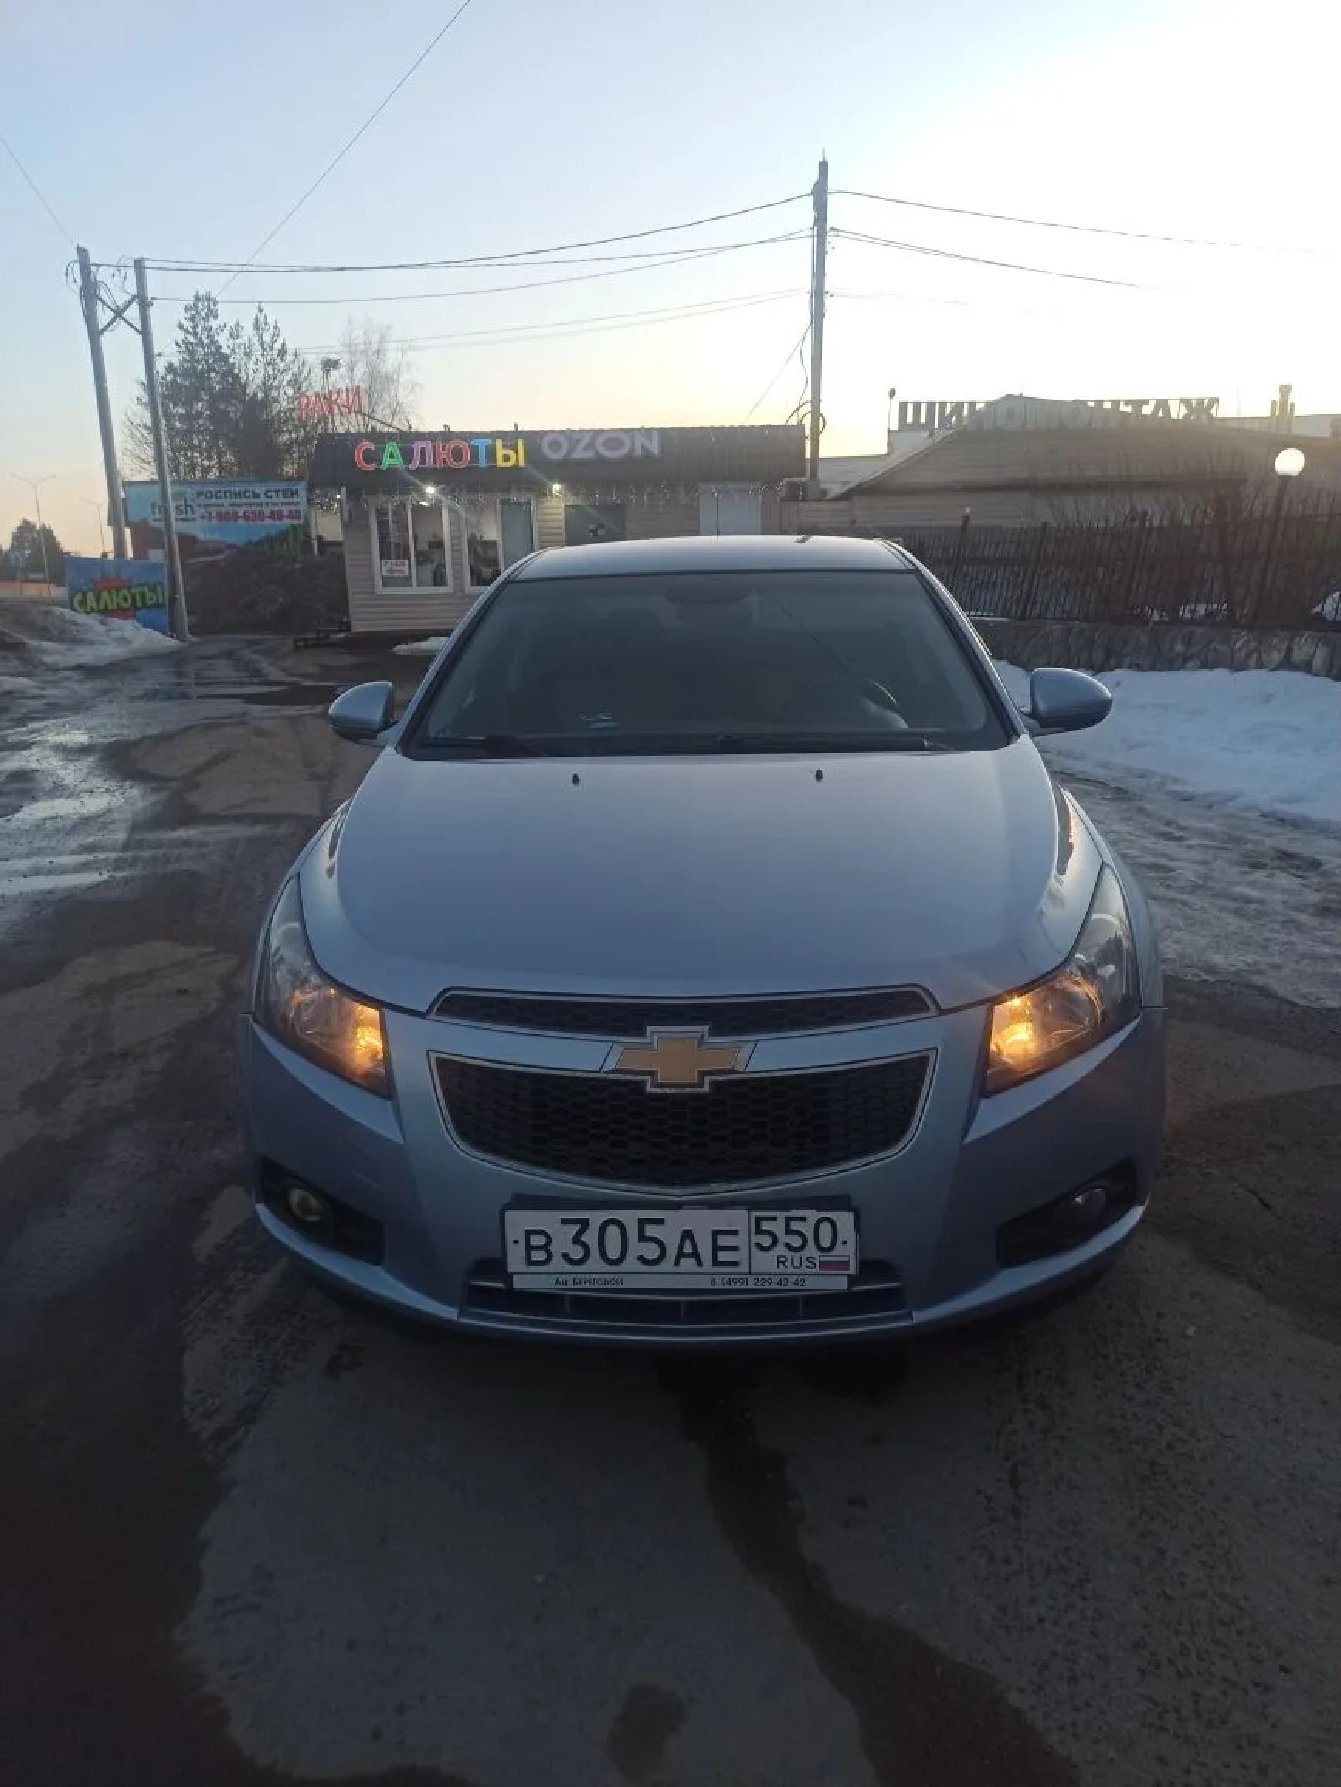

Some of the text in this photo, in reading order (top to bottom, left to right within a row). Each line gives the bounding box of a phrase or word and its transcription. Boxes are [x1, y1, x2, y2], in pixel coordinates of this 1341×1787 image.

[354, 438, 526, 470] САЛЮТЫ
[541, 429, 662, 460] OZON
[151, 496, 195, 516] frsh
[196, 487, 299, 500] РОСПИСЬ СТЕН
[72, 585, 164, 612] САЛЮТЫ
[753, 1215, 838, 1253] 550
[775, 1255, 817, 1270] RUS
